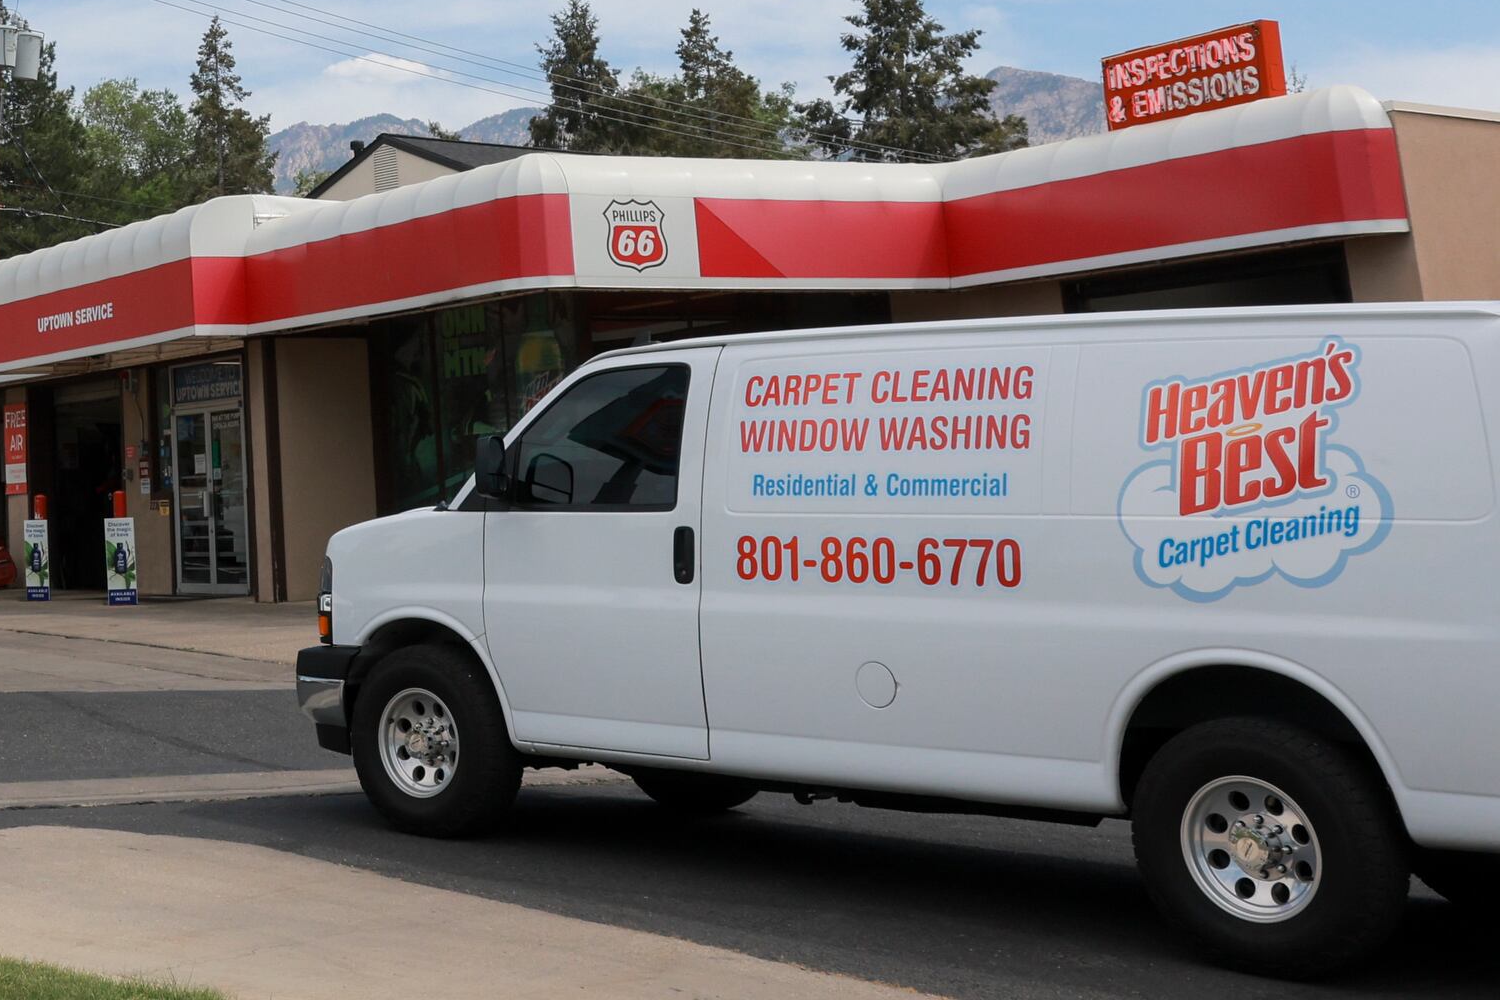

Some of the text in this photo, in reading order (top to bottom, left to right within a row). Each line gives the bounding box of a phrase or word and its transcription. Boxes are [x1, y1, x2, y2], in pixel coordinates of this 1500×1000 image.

[1107, 32, 1256, 90] INSPECTIONS
[1108, 66, 1260, 123] & EMISSIONS
[612, 210, 656, 222] PHILLIPS
[618, 229, 655, 256] 66
[37, 302, 113, 333] UPTOWN SERVICE
[176, 383, 209, 401] UPTOWN
[745, 366, 1034, 407] CARPET CLEANING
[1146, 343, 1352, 443] Heaven's
[5, 410, 26, 429] FREE
[740, 414, 1031, 452] WINDOW WASHING
[10, 434, 24, 452] AIR
[1179, 411, 1328, 516] Best
[753, 473, 1007, 496] Residential & Commercial
[1158, 505, 1360, 568] Carpet Cleaning
[736, 535, 1022, 588] 801-860-6770
